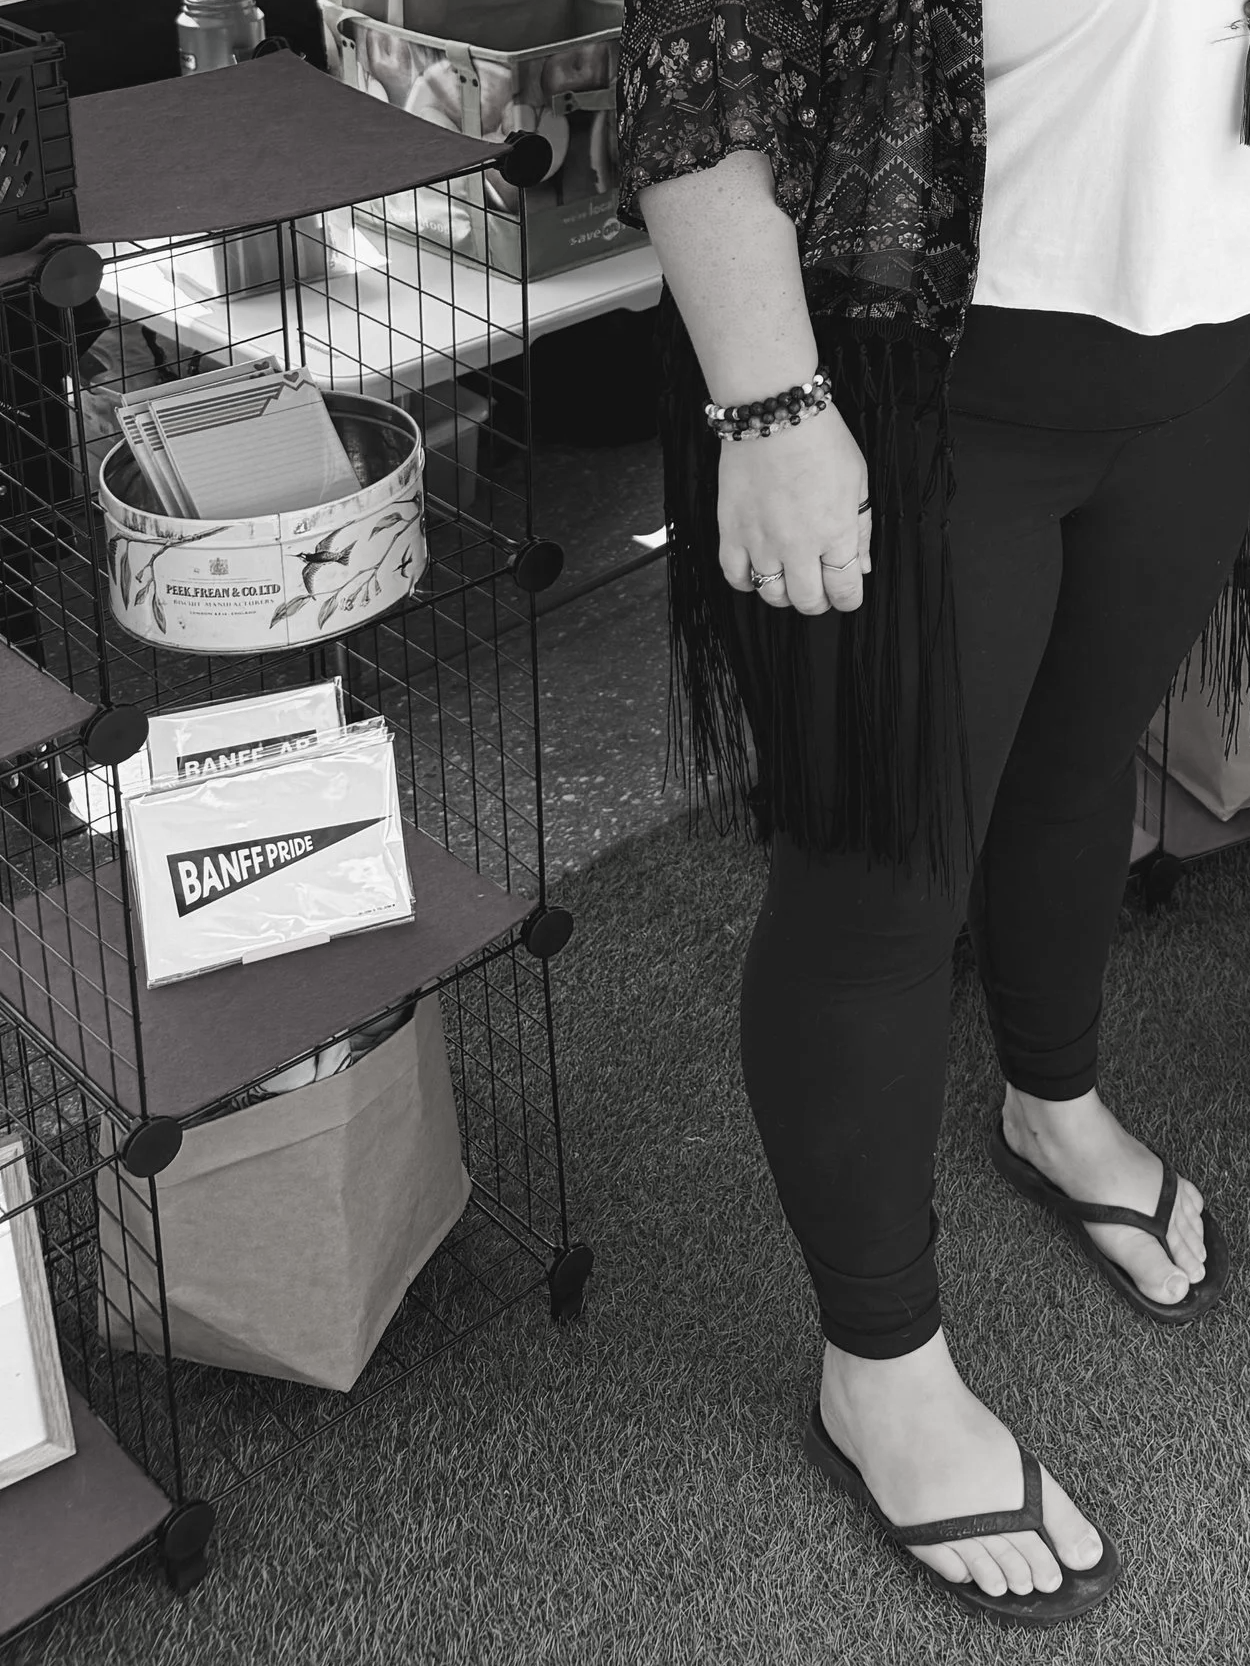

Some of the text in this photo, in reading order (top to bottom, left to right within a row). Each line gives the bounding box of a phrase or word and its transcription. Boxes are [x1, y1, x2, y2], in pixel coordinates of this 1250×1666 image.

[194, 587, 230, 598] FREAN
[231, 587, 241, 597] &
[259, 583, 281, 596] LTD
[185, 747, 263, 776] BANFF
[178, 834, 314, 906] BANFF PRIDE
